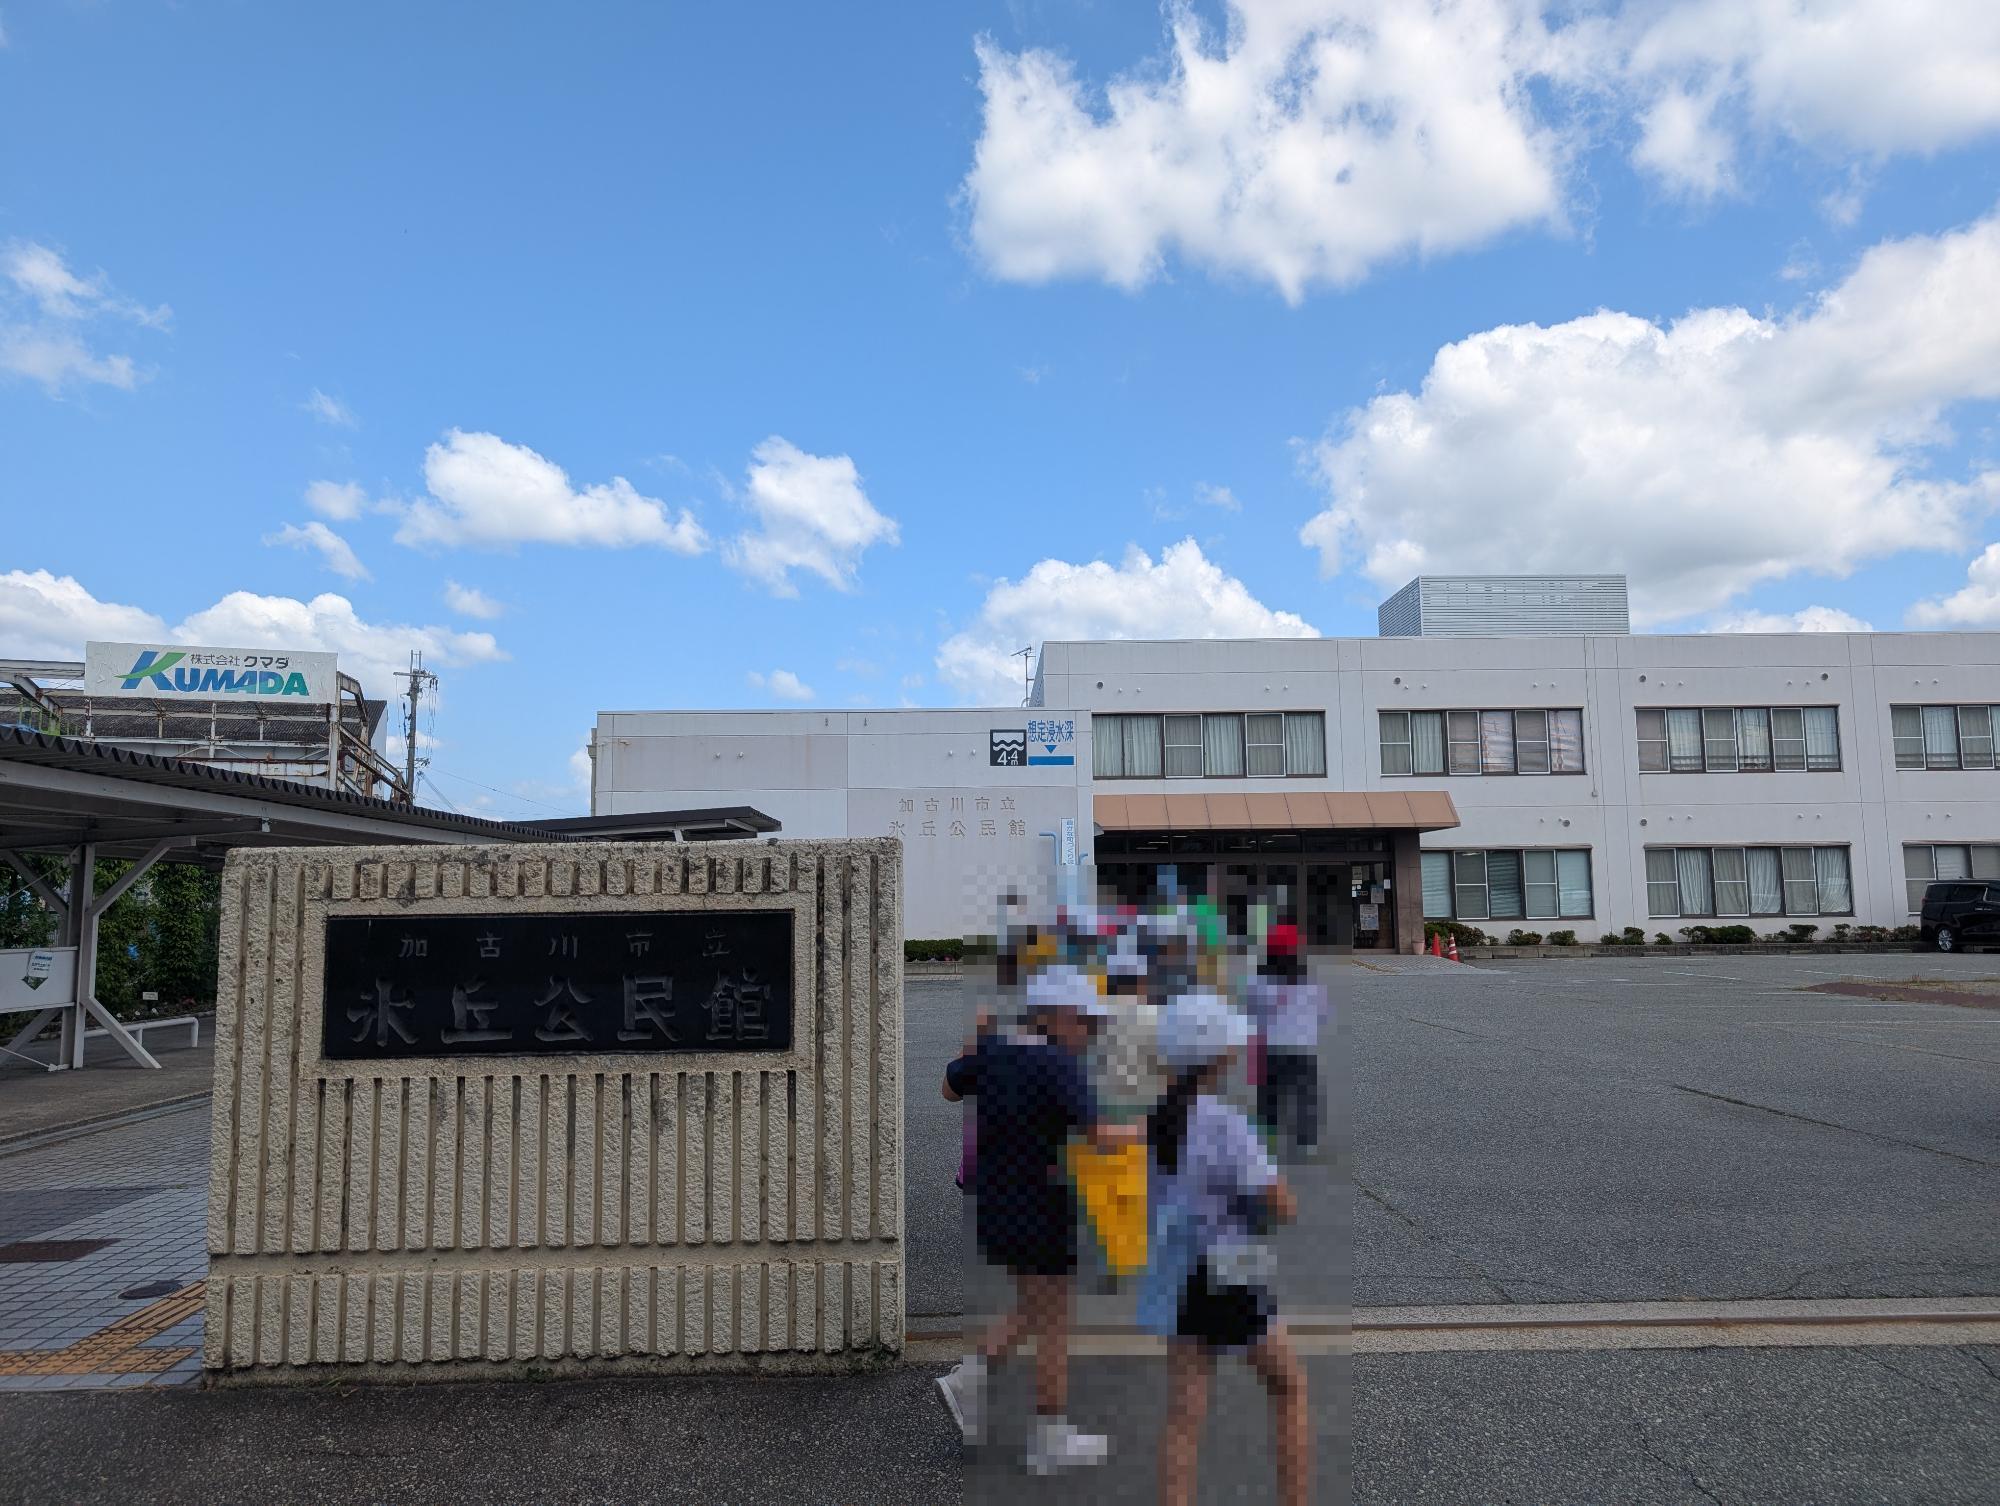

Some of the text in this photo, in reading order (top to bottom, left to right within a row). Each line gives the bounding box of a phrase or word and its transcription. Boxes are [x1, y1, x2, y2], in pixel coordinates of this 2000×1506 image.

[114, 651, 310, 696] KUMADA
[190, 653, 290, 669] 株式会社 クマダ
[1027, 719, 1074, 743] 想定浸水深
[898, 796, 1016, 814] 加古川市立
[398, 929, 731, 959] 加古川市立
[346, 966, 773, 1047] 氷丘公民館
